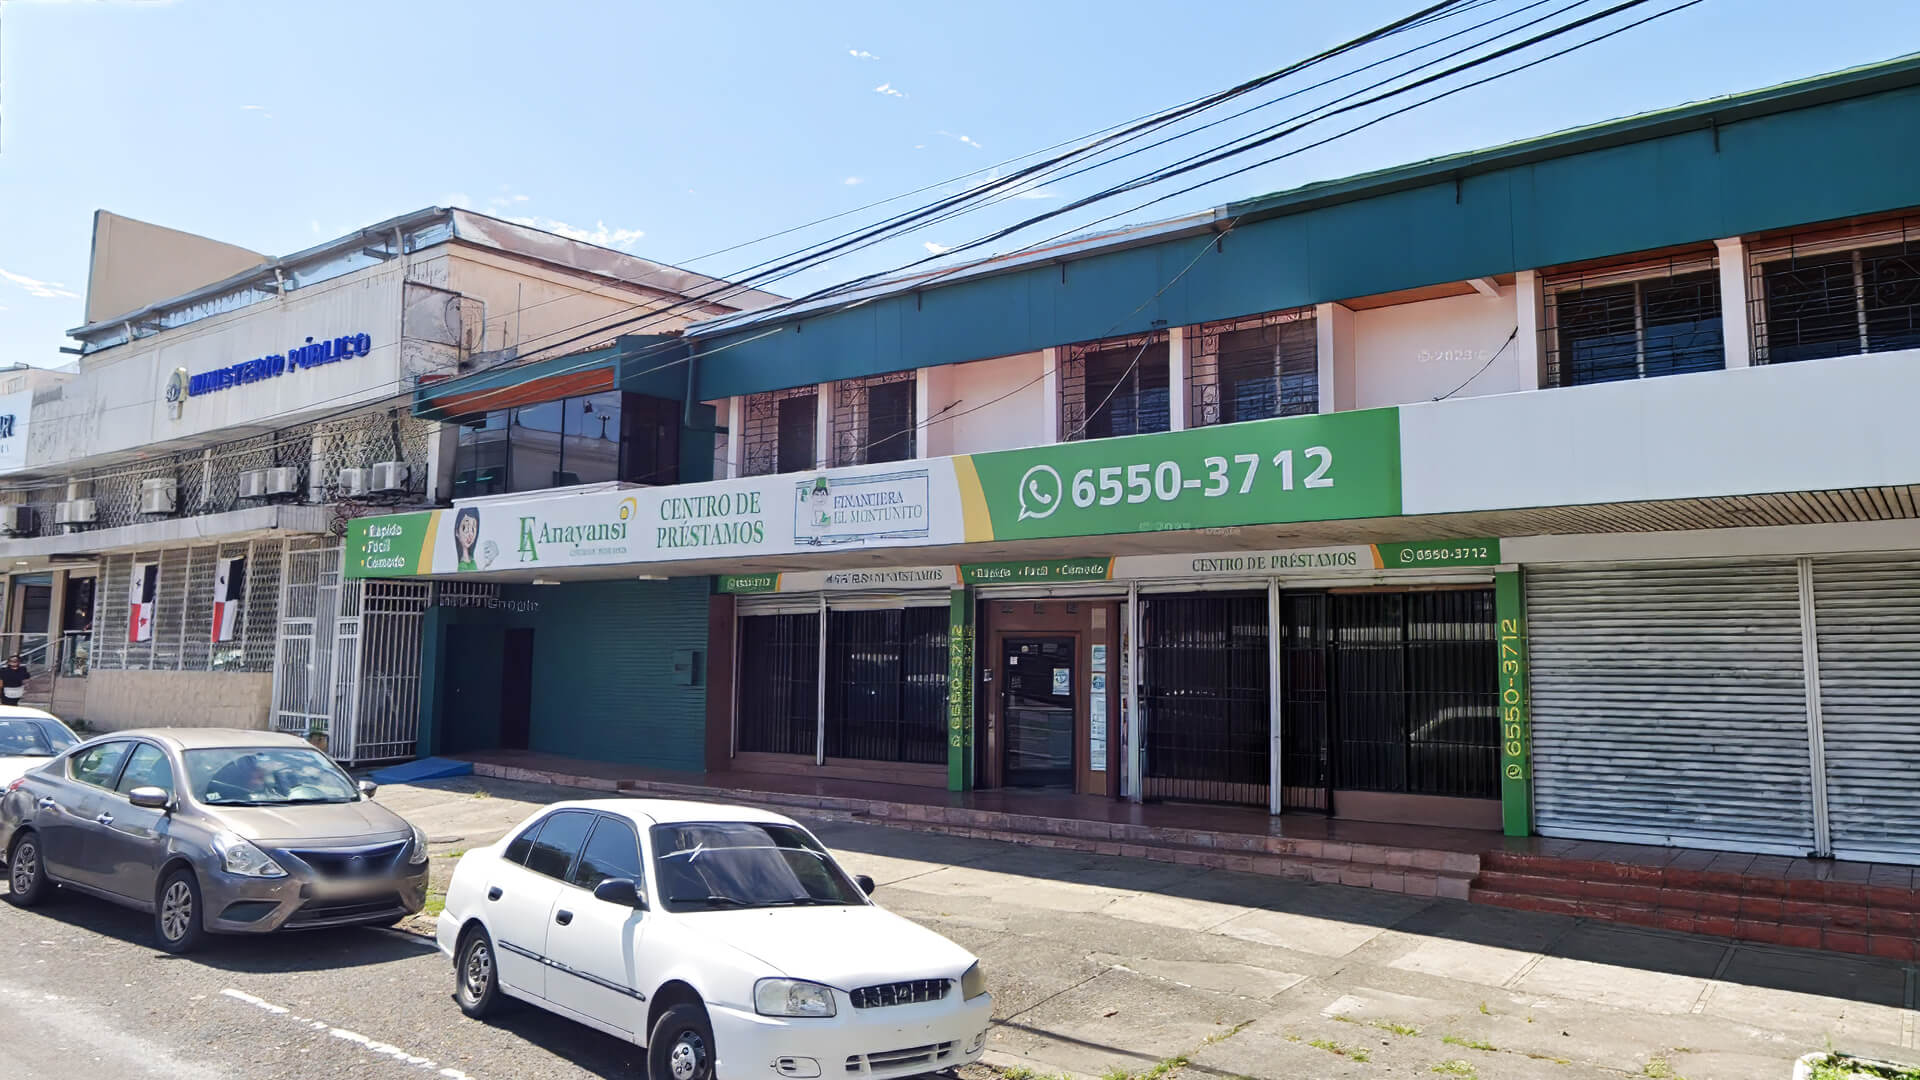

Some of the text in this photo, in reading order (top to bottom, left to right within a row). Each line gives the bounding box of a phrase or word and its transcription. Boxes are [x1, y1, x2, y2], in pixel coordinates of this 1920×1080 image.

[188, 355, 285, 397] MINISTERIO
[1071, 446, 1335, 509] 6550-3712
[660, 491, 761, 520] CENTRO DE
[834, 491, 904, 509] FINANCIERA
[538, 514, 627, 547] Anayansi
[656, 520, 764, 549] PRÉSTAMOS
[1192, 551, 1356, 572] CENTRO DE PRÉSTAMOS
[1501, 618, 1521, 757] 6550-3712
